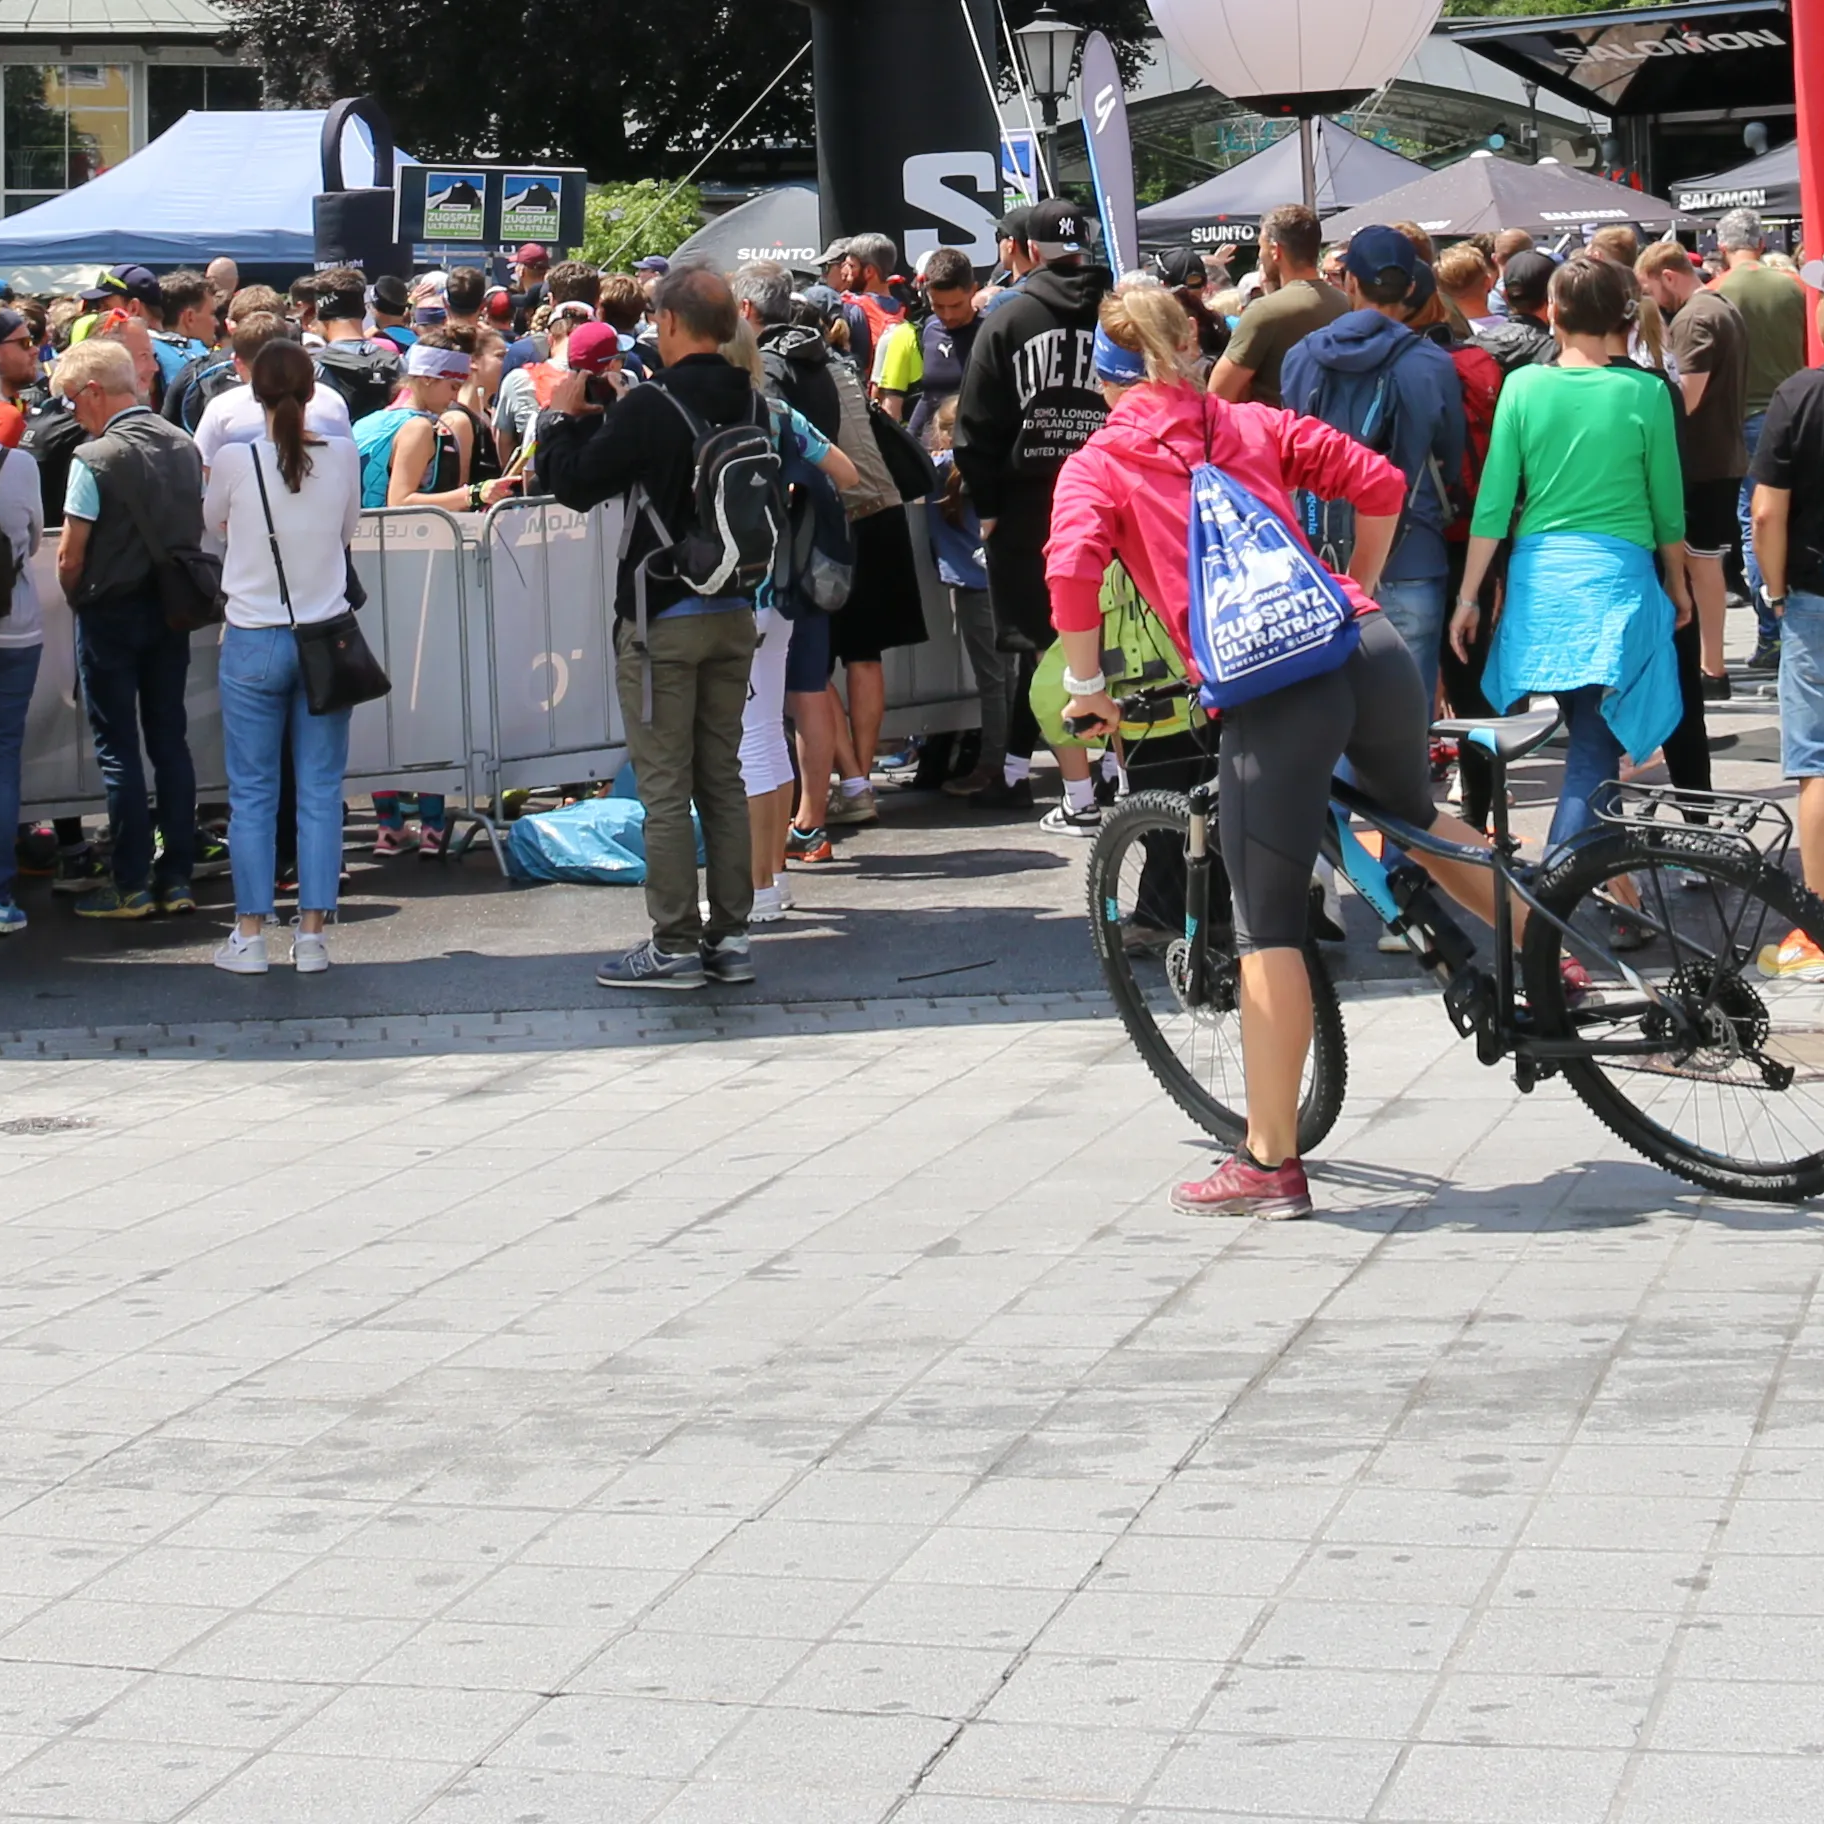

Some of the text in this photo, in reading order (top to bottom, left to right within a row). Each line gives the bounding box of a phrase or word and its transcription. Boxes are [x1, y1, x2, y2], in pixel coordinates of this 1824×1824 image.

[1554, 28, 1787, 64] SALOMON
[1680, 189, 1766, 210] SALOMON
[428, 213, 480, 224] ZUGSPITZ
[504, 214, 556, 225] ZUGSPITZ
[427, 223, 479, 232] ULTRATRAIL
[504, 224, 554, 233] ULTRATRAIL
[1190, 225, 1255, 244] SUUNTO
[737, 247, 816, 261] SUUNTO
[1012, 328, 1066, 410] LIVE
[1076, 420, 1106, 431] STRE
[1024, 447, 1055, 457] UNITED
[1213, 586, 1327, 648] ZUGSPITZ
[1219, 605, 1337, 662] ULTRATRAIL
